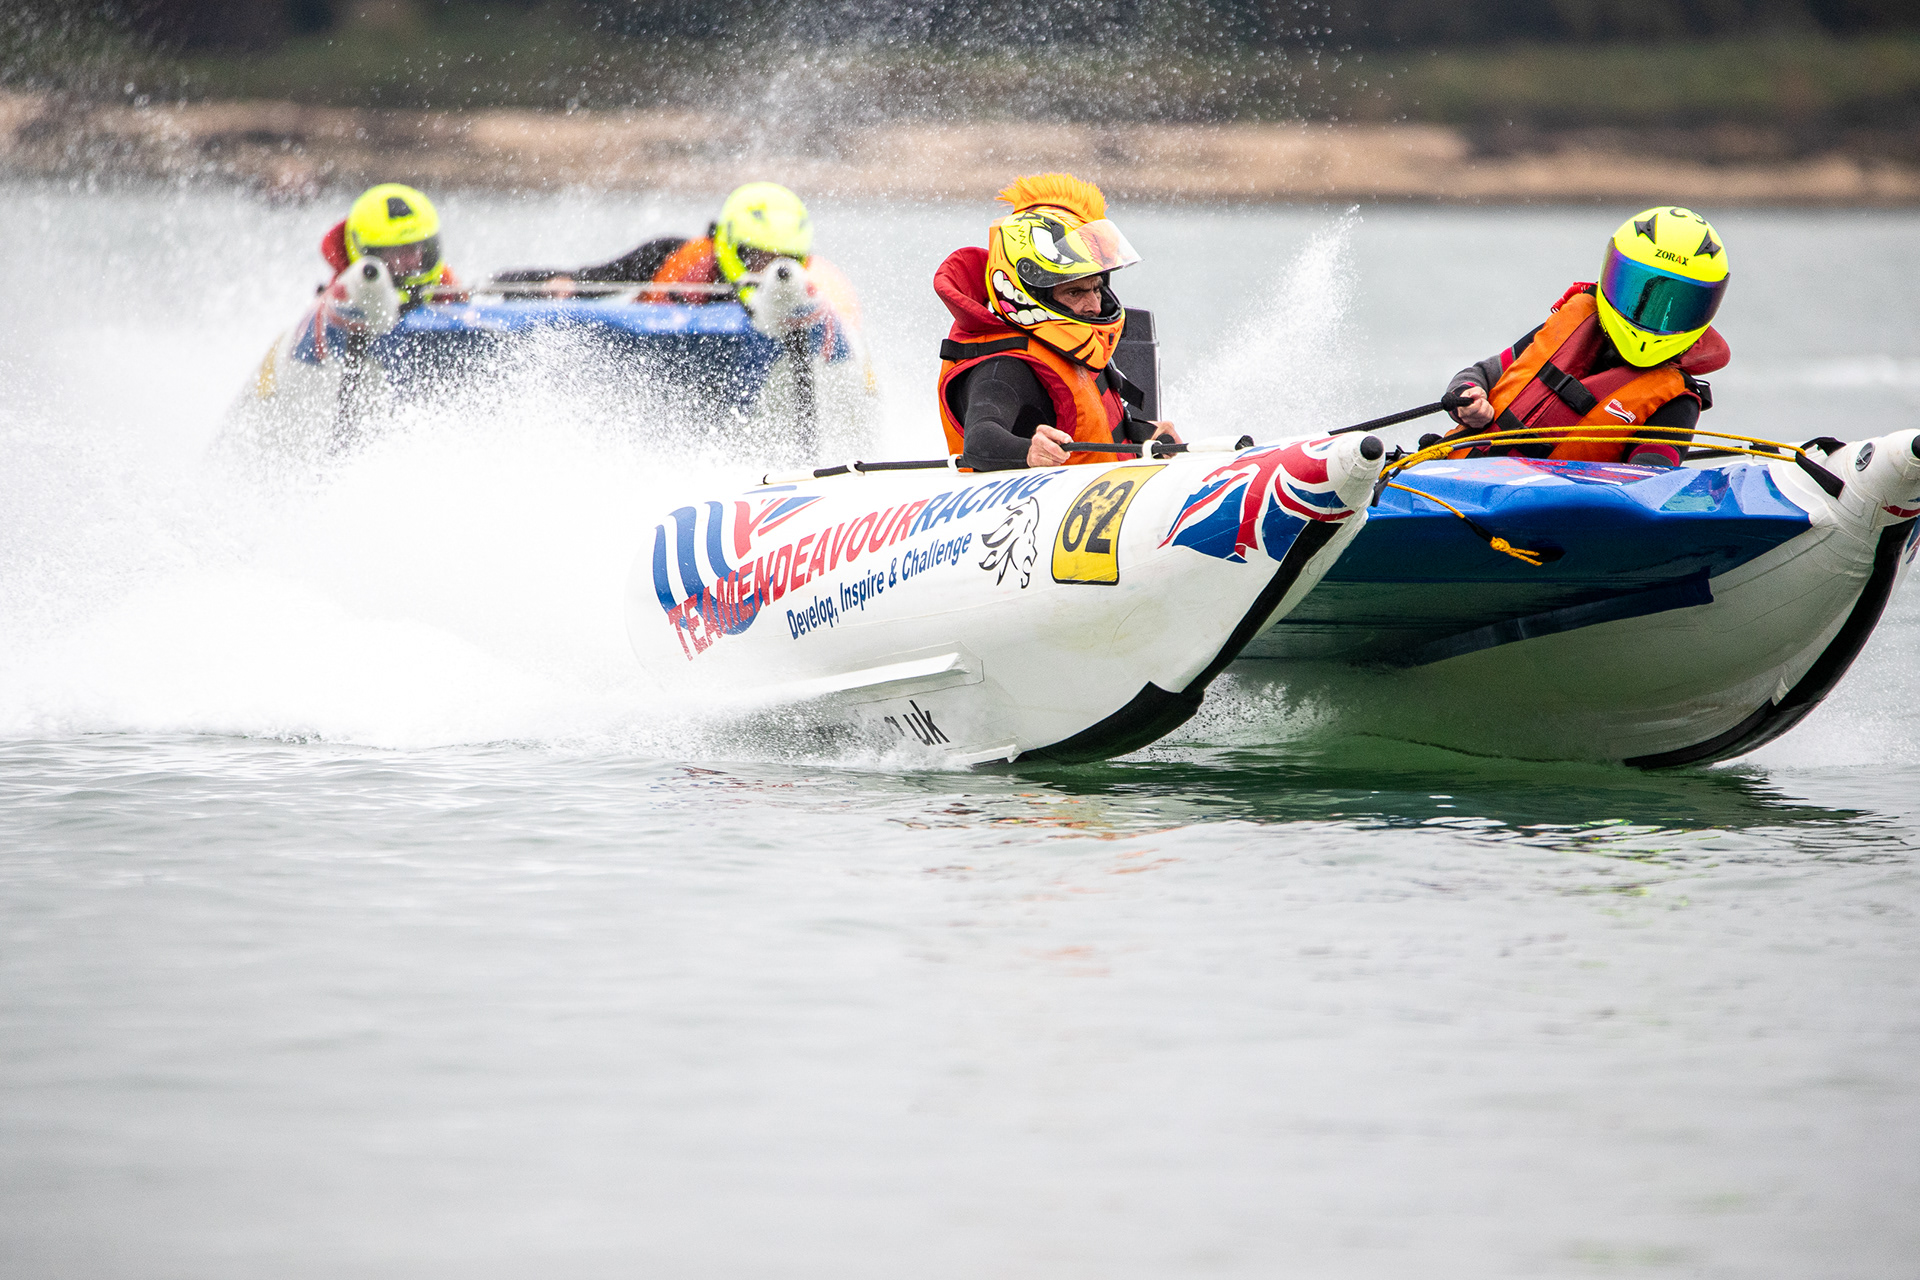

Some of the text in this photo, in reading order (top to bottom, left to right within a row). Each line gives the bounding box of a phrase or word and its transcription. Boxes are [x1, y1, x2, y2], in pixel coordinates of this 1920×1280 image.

[1655, 248, 1689, 267] ZORAX
[1062, 480, 1135, 555] 62
[786, 532, 972, 640] Develop, Inspire & Challenge
